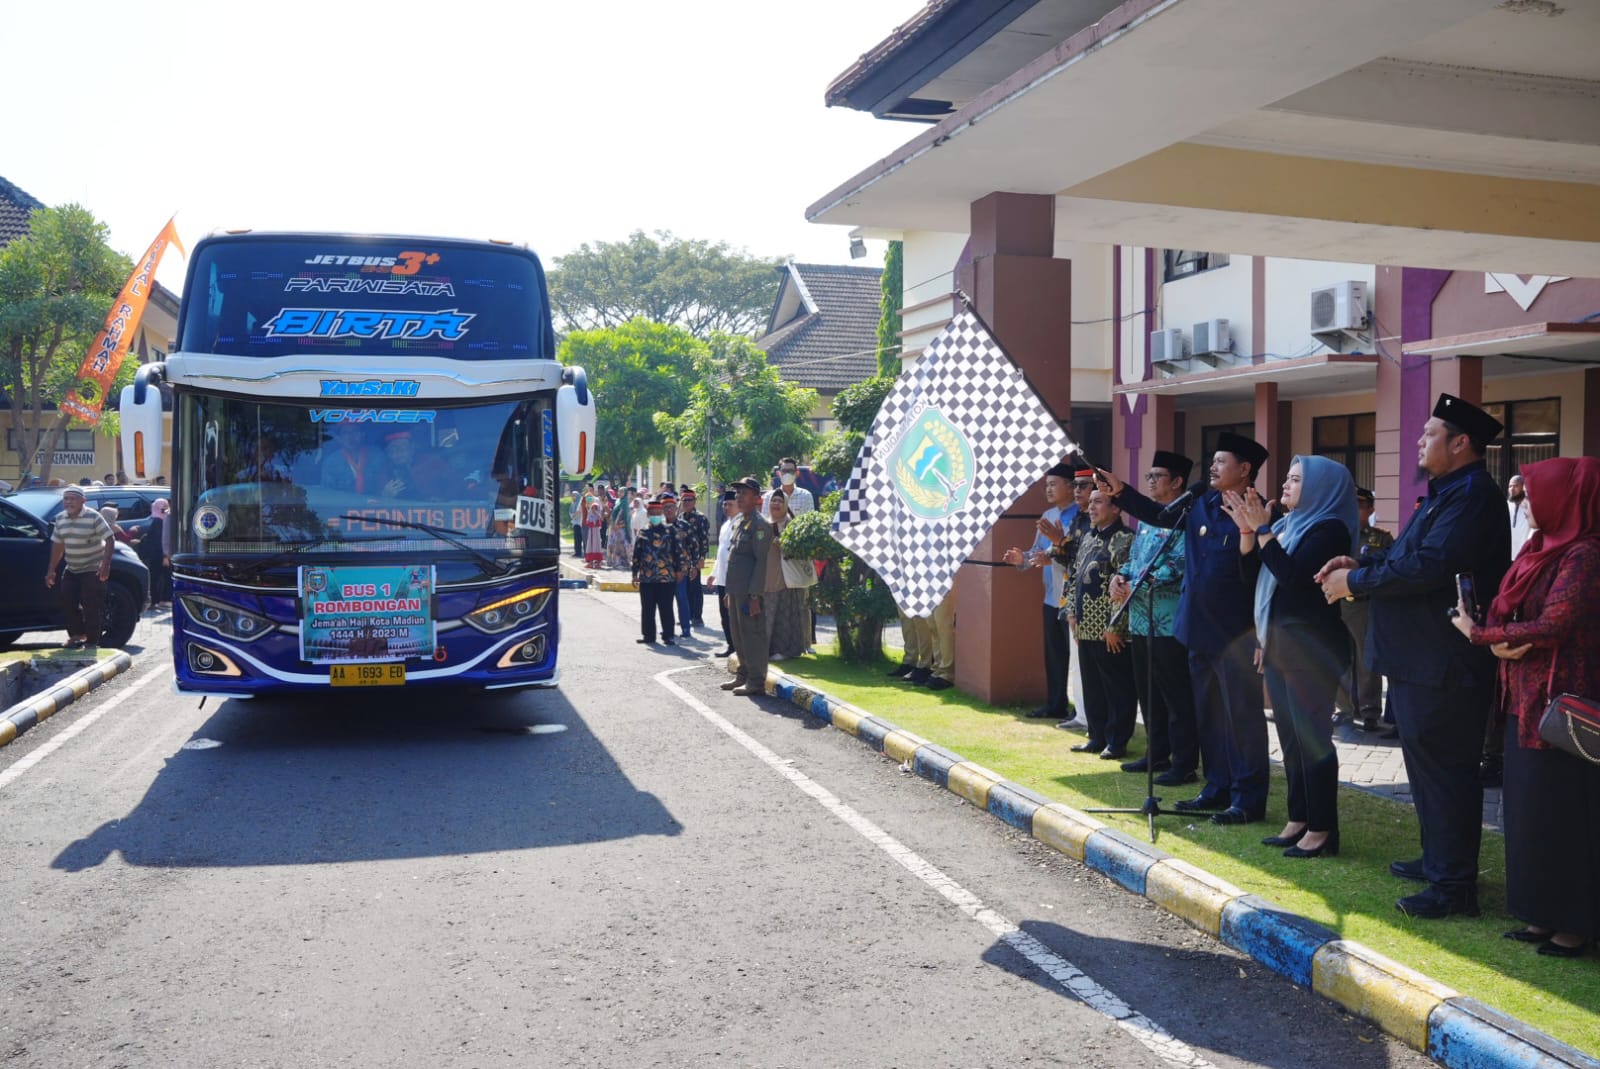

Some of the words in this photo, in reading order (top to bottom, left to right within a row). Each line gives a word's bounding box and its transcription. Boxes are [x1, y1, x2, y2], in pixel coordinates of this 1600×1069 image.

[305, 254, 398, 266] JETBUS
[284, 277, 456, 297] PARIWISATA
[262, 308, 477, 341] BIRTA
[92, 303, 132, 373] RAHMAH
[309, 409, 437, 423] VOYAGER
[520, 499, 546, 529] BUS
[343, 584, 376, 597] BUS
[380, 583, 391, 596] 1
[314, 599, 421, 615] ROMBONGAN
[349, 618, 367, 629] Haji
[369, 617, 390, 627] Kota
[393, 616, 425, 626] Madiun
[331, 630, 354, 639] 1444
[357, 630, 364, 638] H
[372, 629, 396, 638] 2023
[399, 628, 409, 638] M
[333, 667, 346, 679] AA
[357, 666, 383, 679] 1693
